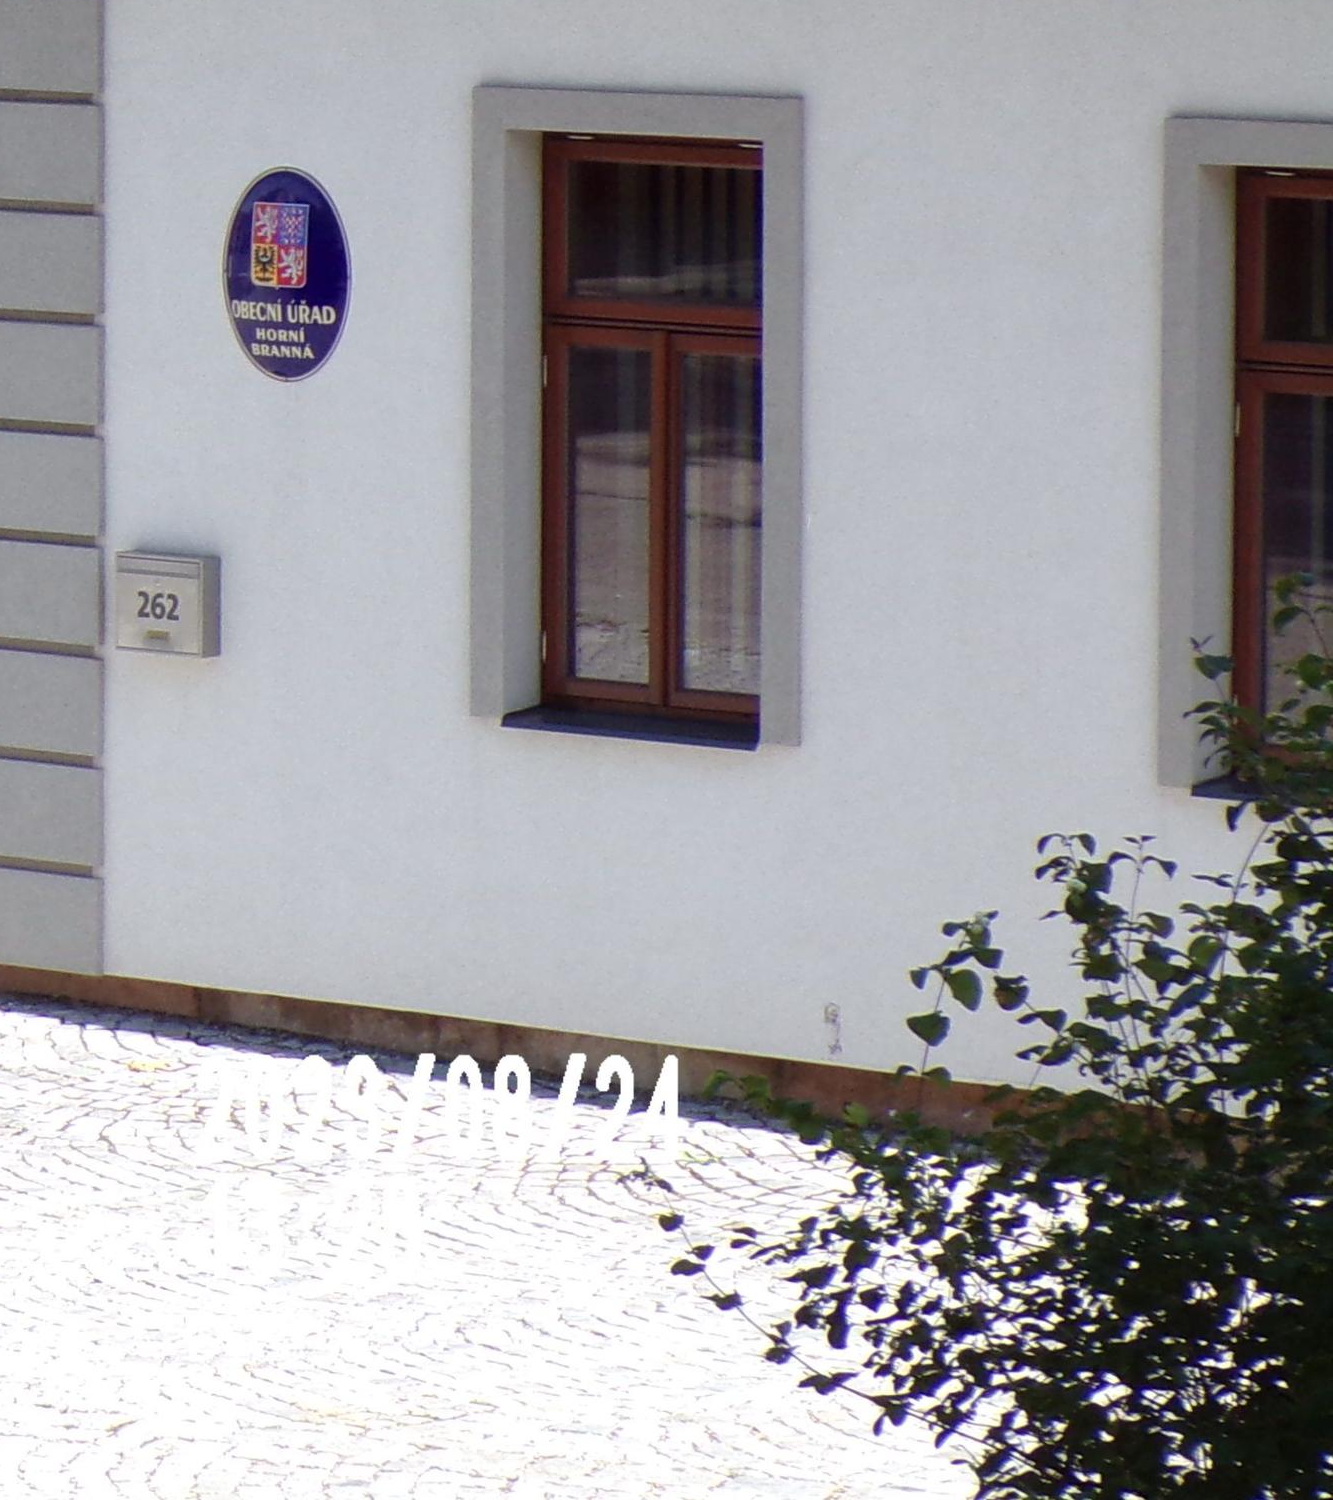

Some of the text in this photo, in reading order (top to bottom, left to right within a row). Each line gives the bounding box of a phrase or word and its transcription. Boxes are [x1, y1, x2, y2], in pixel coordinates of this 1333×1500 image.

[232, 298, 337, 325] OBECNÍ ÚŘAD
[255, 326, 305, 343] HORNÍ
[251, 343, 315, 359] BRANNÁ
[137, 591, 180, 621] 262
